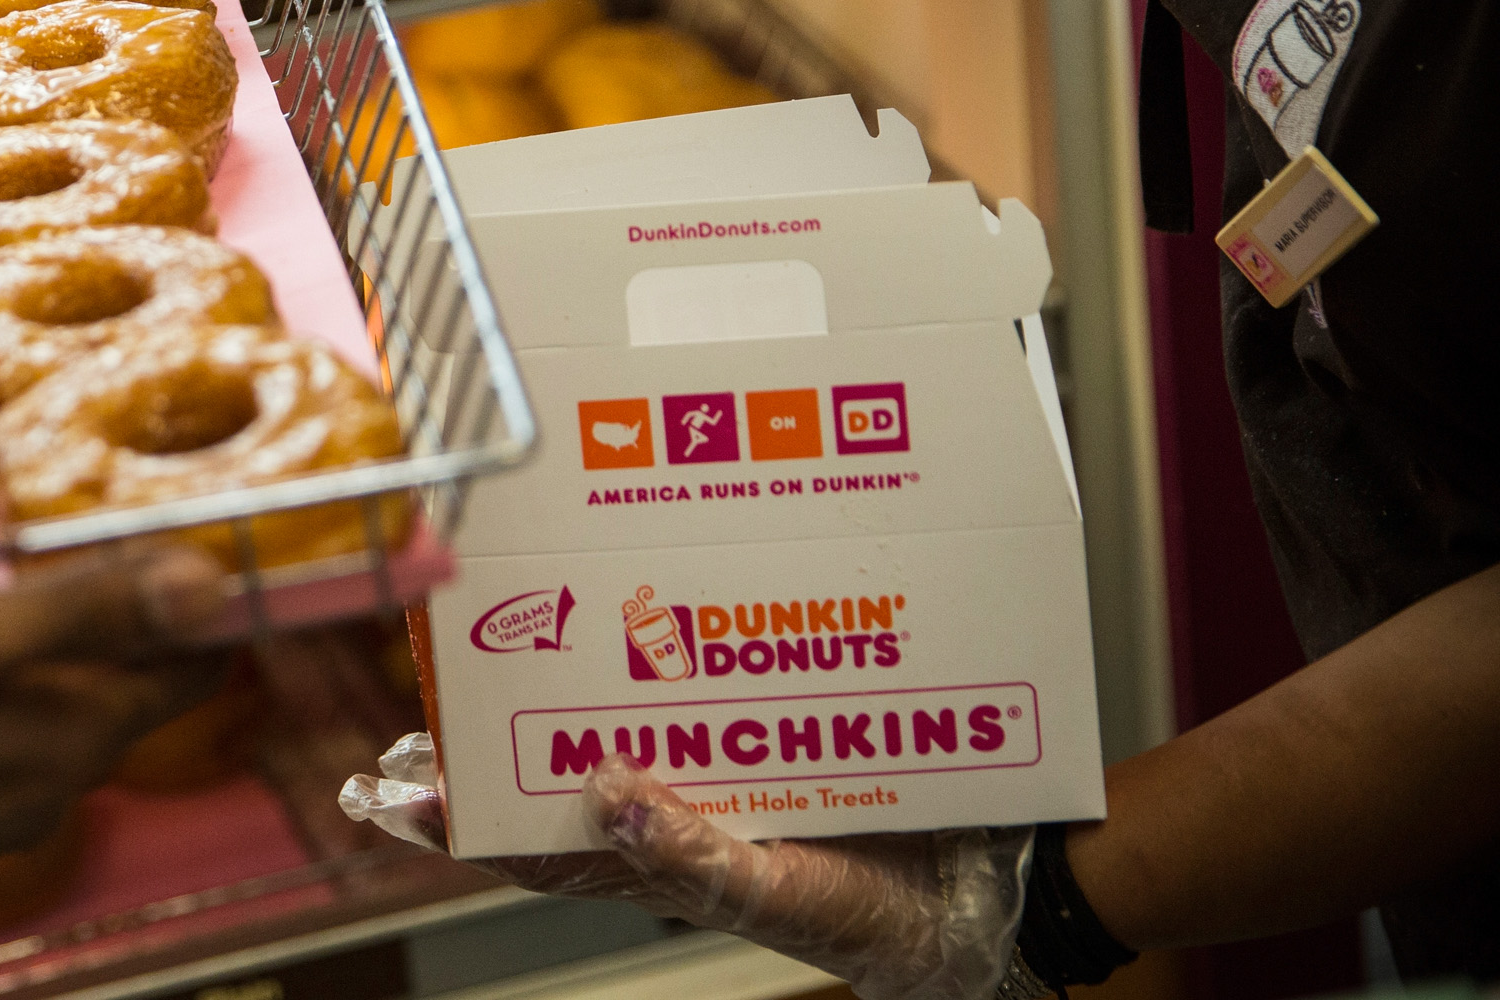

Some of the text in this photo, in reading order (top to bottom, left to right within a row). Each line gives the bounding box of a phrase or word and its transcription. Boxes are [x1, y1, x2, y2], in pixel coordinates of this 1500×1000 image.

[627, 218, 821, 243] DunkinDonuts.com
[1274, 188, 1337, 253] MARIA SUPERVISOR
[769, 415, 797, 431] ON
[587, 485, 692, 506] AMERICA
[700, 481, 761, 500] RUNS
[769, 478, 804, 496] ON
[499, 601, 554, 630] GRAMS
[697, 594, 906, 640] DUNKIN'
[497, 616, 553, 644] TRANS FAT
[687, 785, 899, 815] nut Hole Treats
